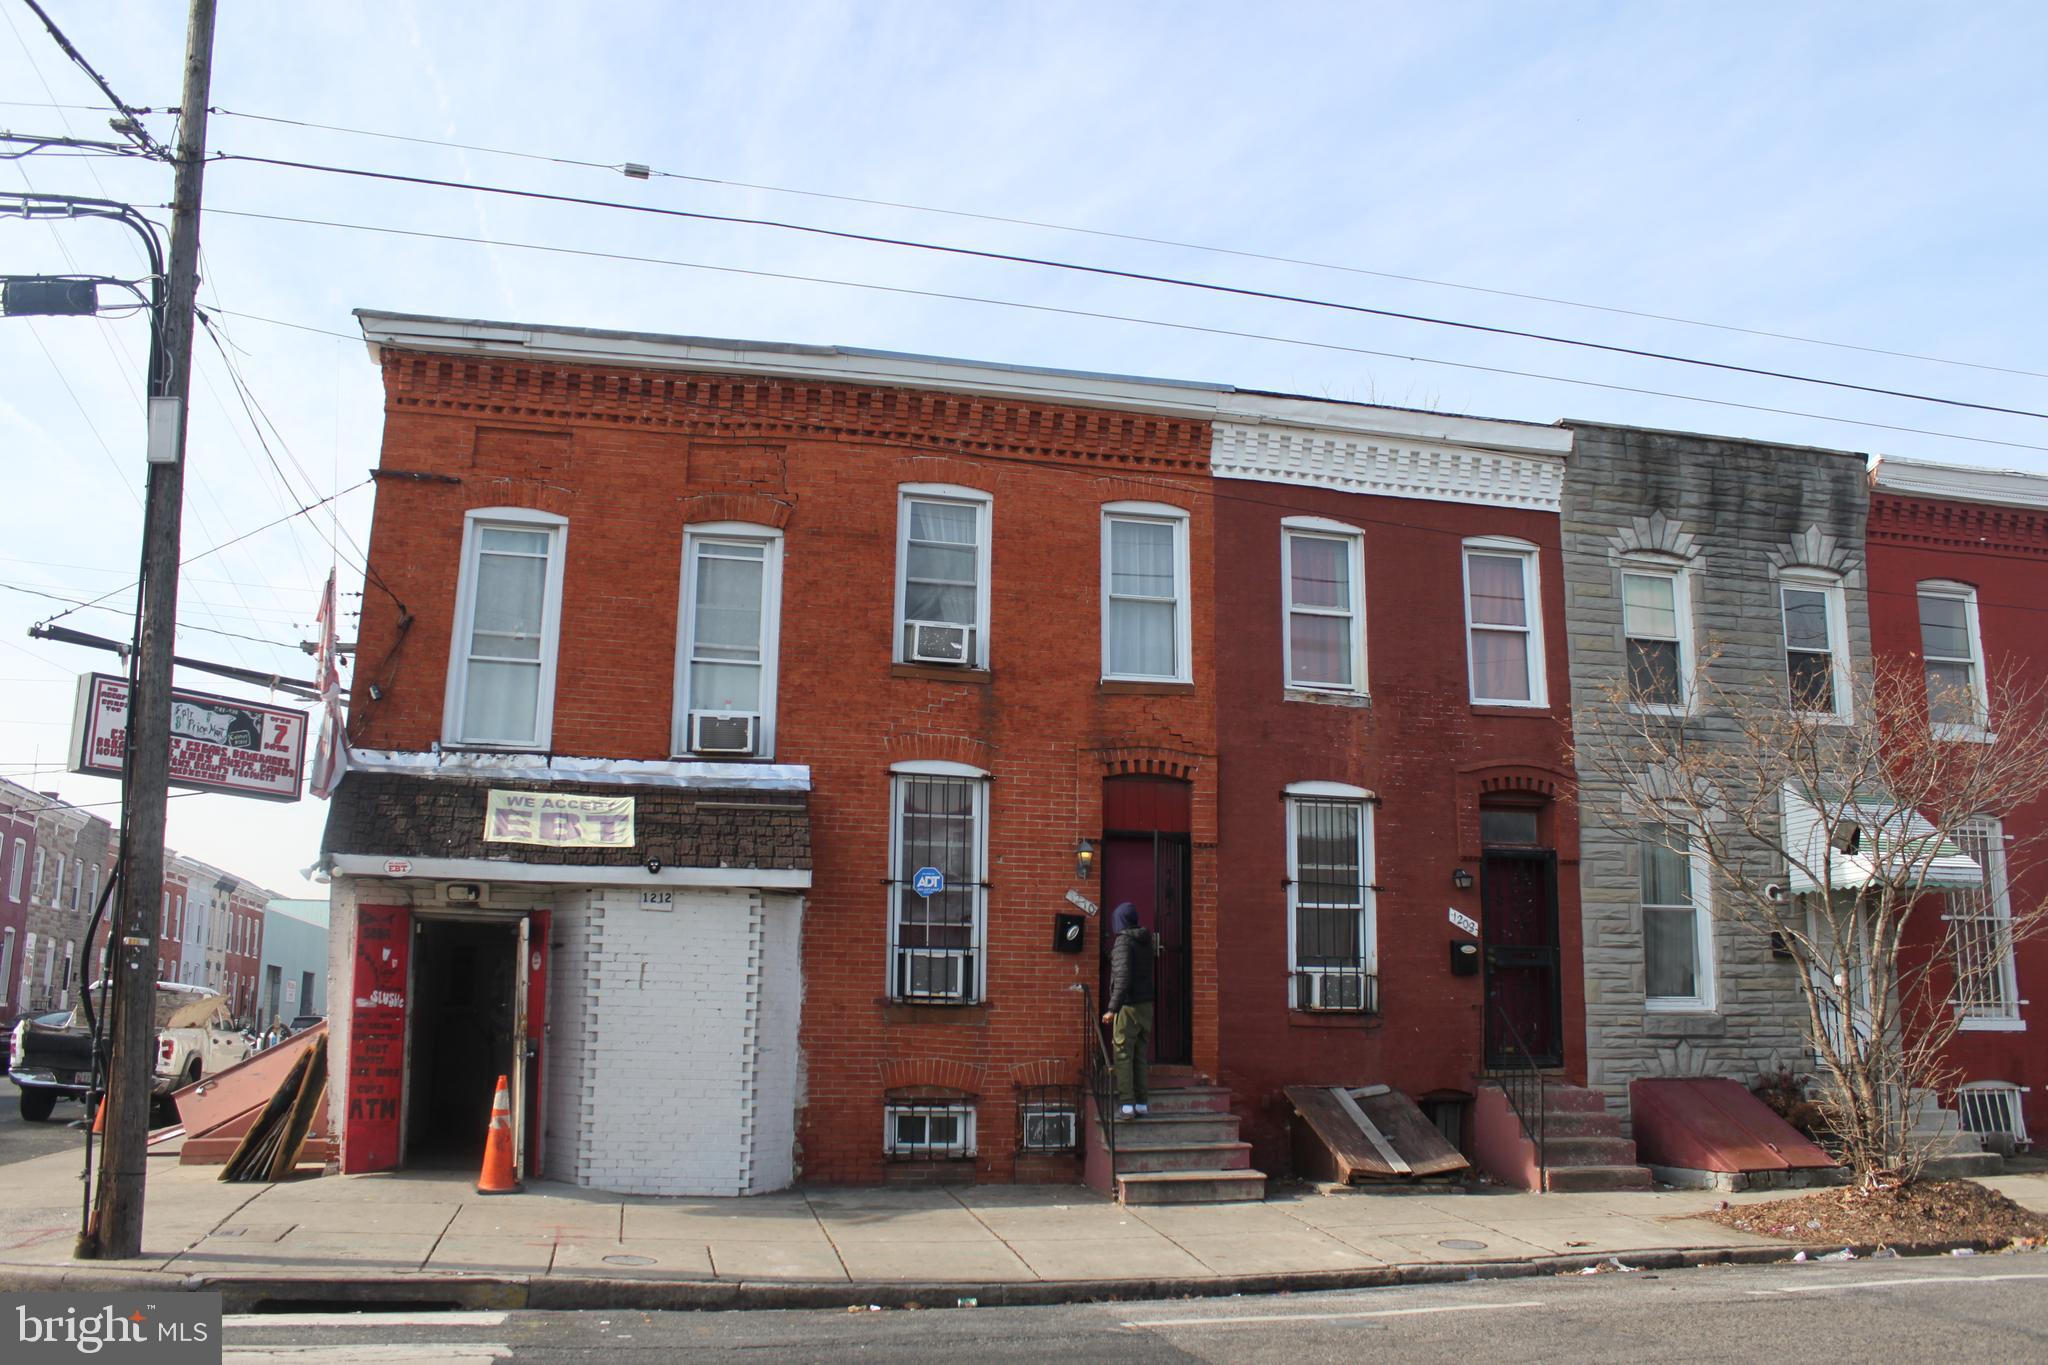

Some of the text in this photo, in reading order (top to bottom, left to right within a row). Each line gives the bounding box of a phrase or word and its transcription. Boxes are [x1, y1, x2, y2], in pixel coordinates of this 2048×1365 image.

[274, 724, 288, 744] 7
[507, 796, 535, 808] WE
[494, 808, 629, 842] EBT
[917, 875, 941, 888] ADT
[643, 892, 672, 904] 1212
[350, 1098, 396, 1120] ATM
